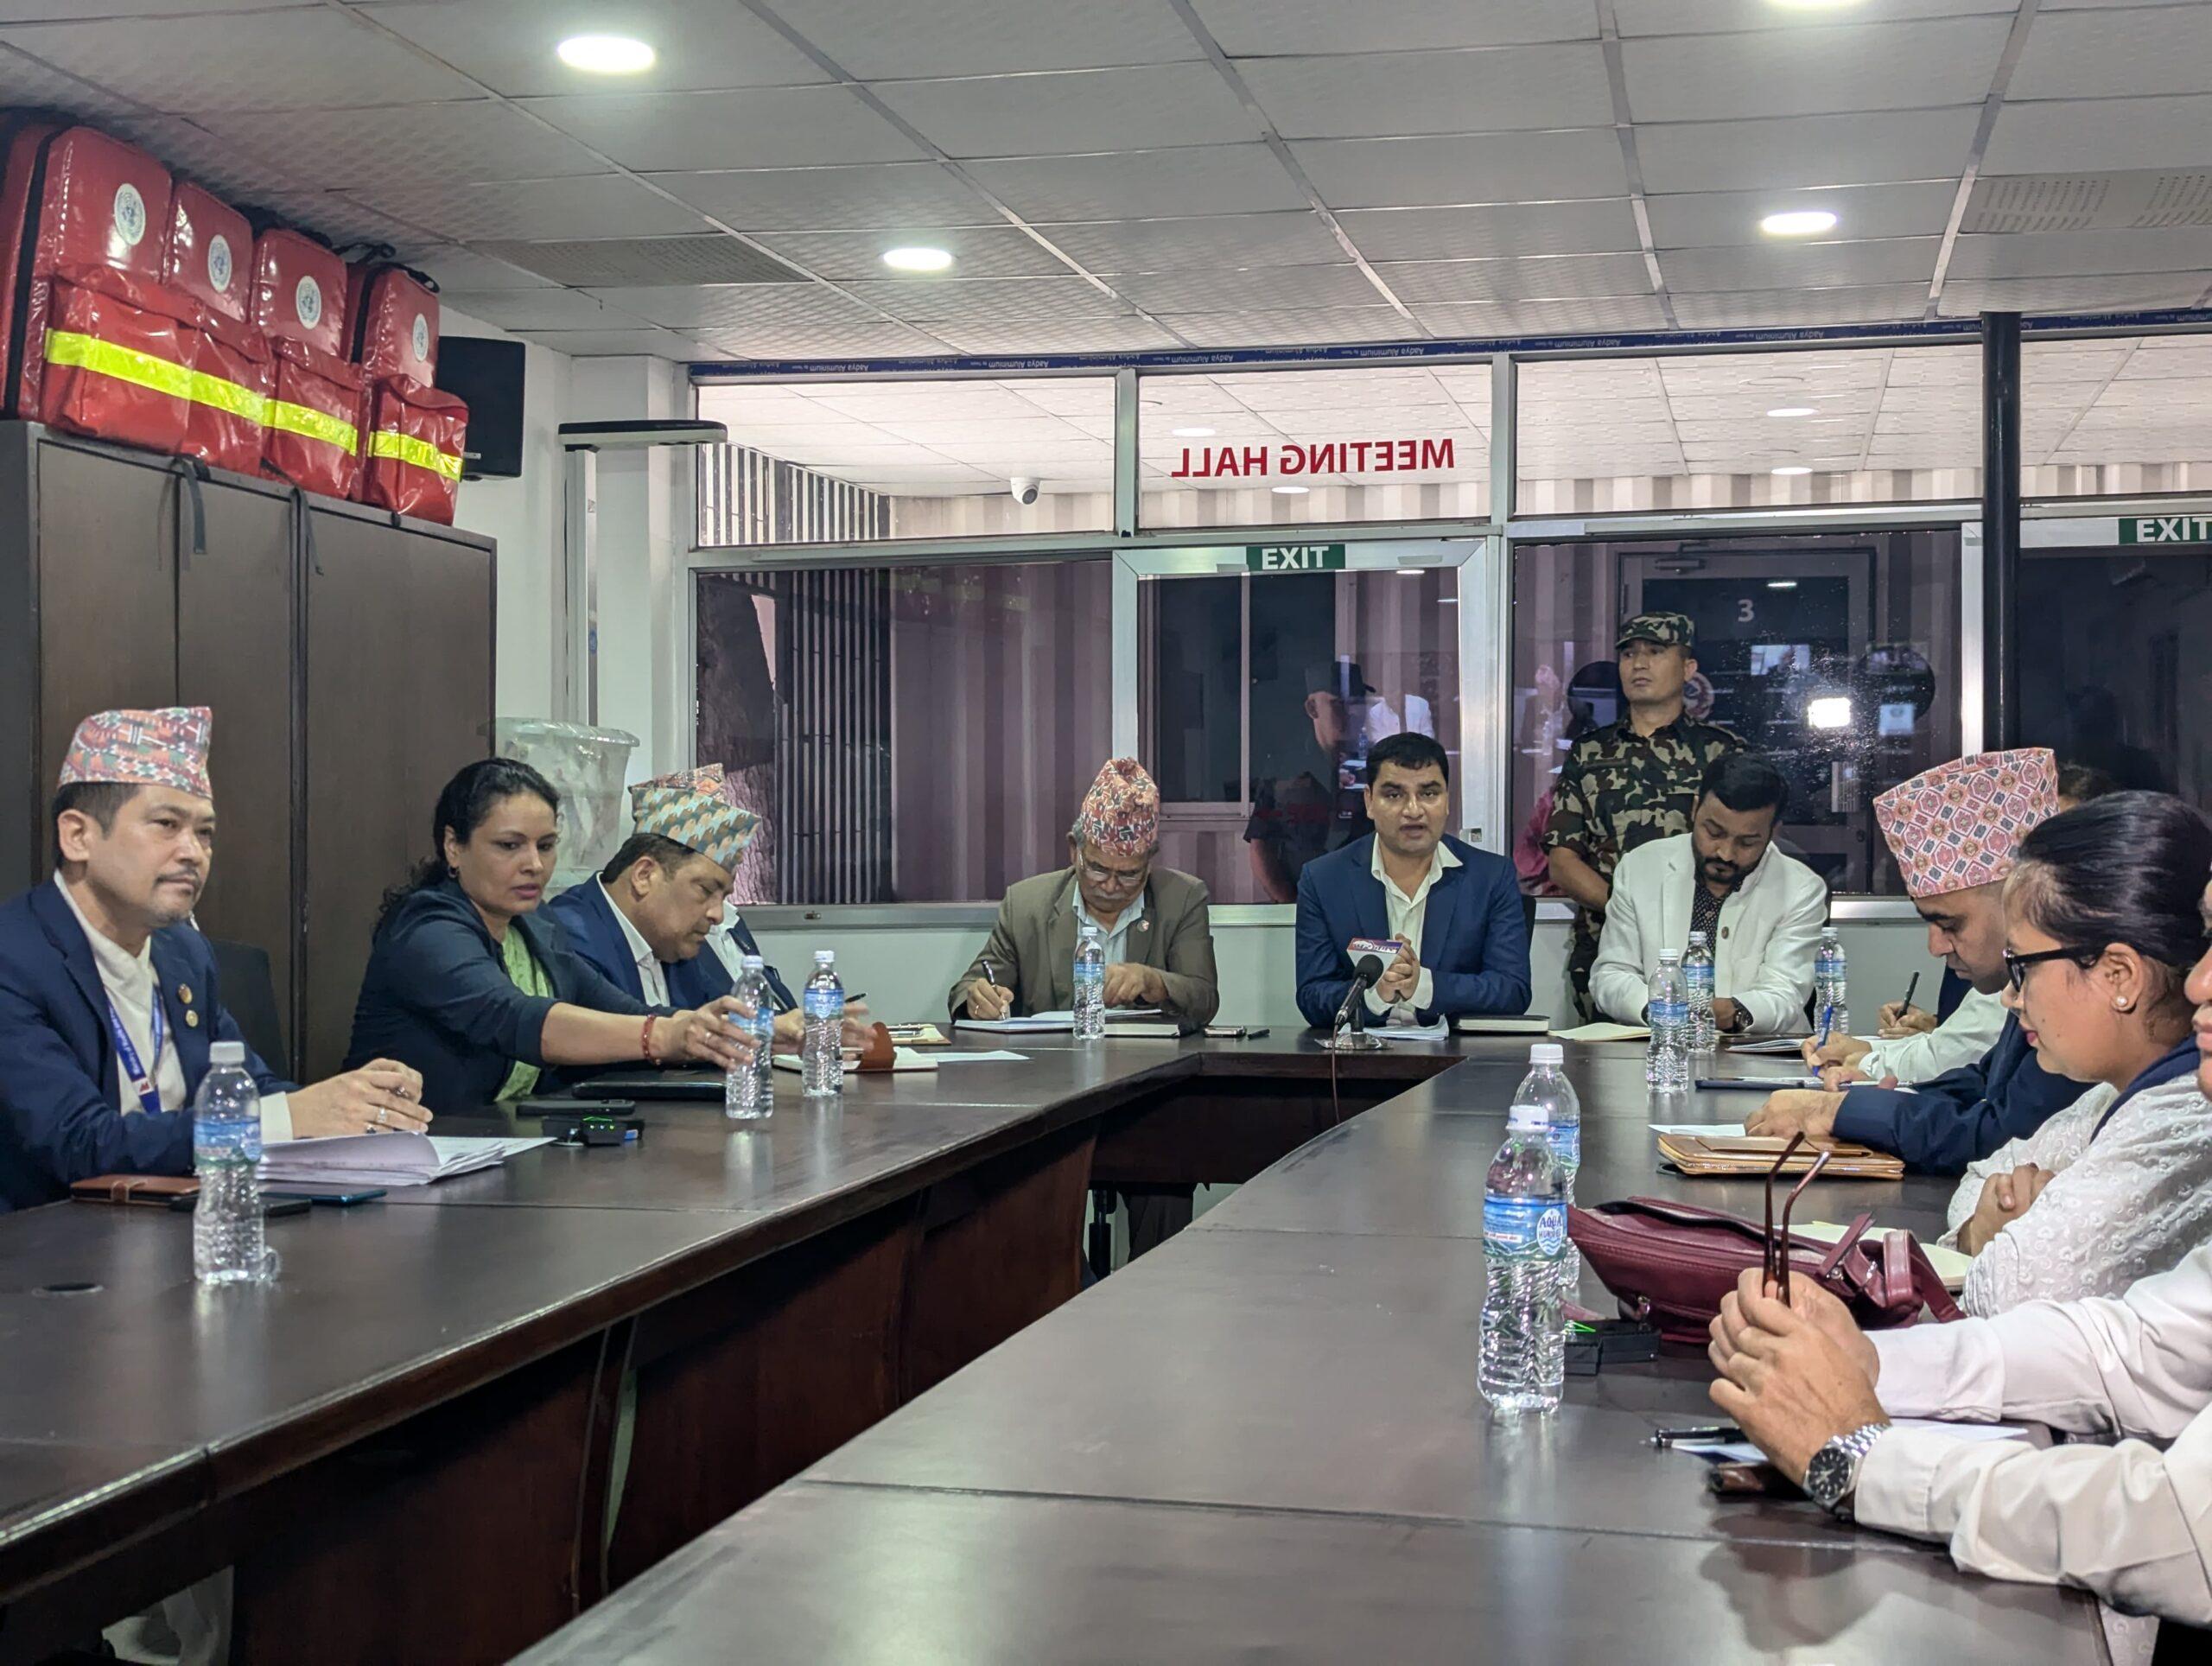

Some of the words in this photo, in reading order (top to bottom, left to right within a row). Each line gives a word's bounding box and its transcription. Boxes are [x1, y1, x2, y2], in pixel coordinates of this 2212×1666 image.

[1755, 331, 1798, 340] Aluminium
[1800, 330, 1824, 340] Aadya
[1554, 340, 1595, 348] Aluminium
[1597, 338, 1621, 347] Aadya
[1360, 348, 1399, 357] Aluminium
[1401, 347, 1424, 356] Aadya
[1171, 355, 1210, 364] Aluminium
[1211, 353, 1234, 363] Aadya
[846, 364, 869, 372] Aadya
[1027, 359, 1049, 368] Aadya
[2137, 518, 2212, 542] EXIT
[1262, 545, 1329, 570] EXIT
[1738, 599, 1755, 622] 3
[1540, 1216, 1562, 1230] AQUA
